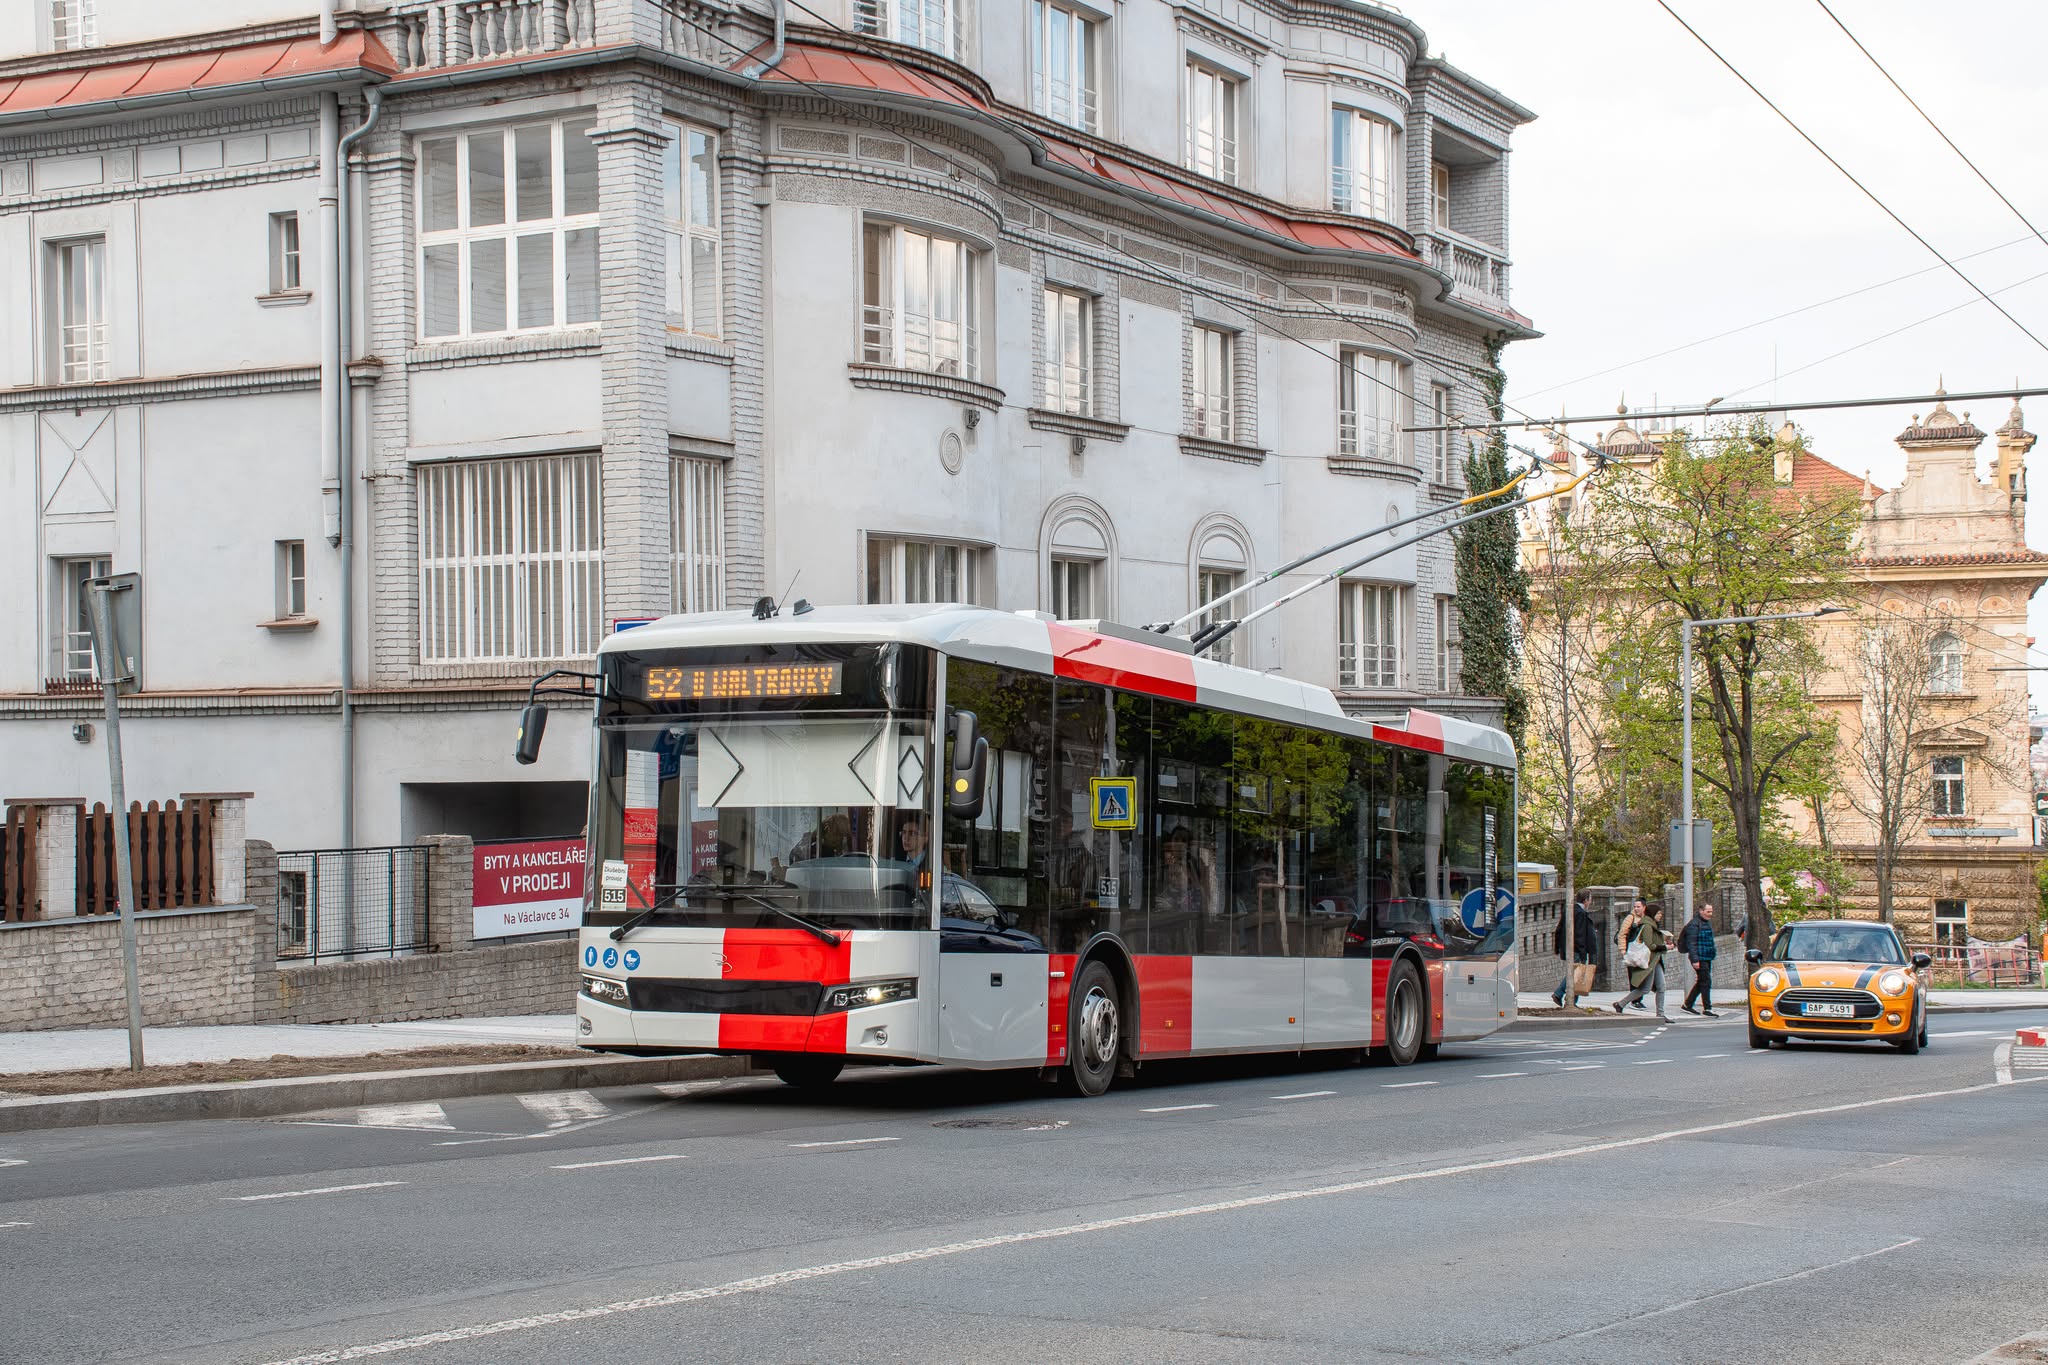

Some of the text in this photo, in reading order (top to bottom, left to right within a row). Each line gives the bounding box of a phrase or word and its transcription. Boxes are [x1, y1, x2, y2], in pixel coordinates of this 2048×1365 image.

[648, 667, 833, 698] 52 U WALTROVKY
[484, 846, 586, 870] BYTY A KANCELÁŘE
[500, 876, 510, 894] V
[513, 871, 571, 893] PRODEJI
[1101, 880, 1117, 895] 515
[604, 890, 624, 902] 515
[503, 907, 570, 925] Na Václavce 34
[1808, 1004, 1850, 1013] 6AP 5491
